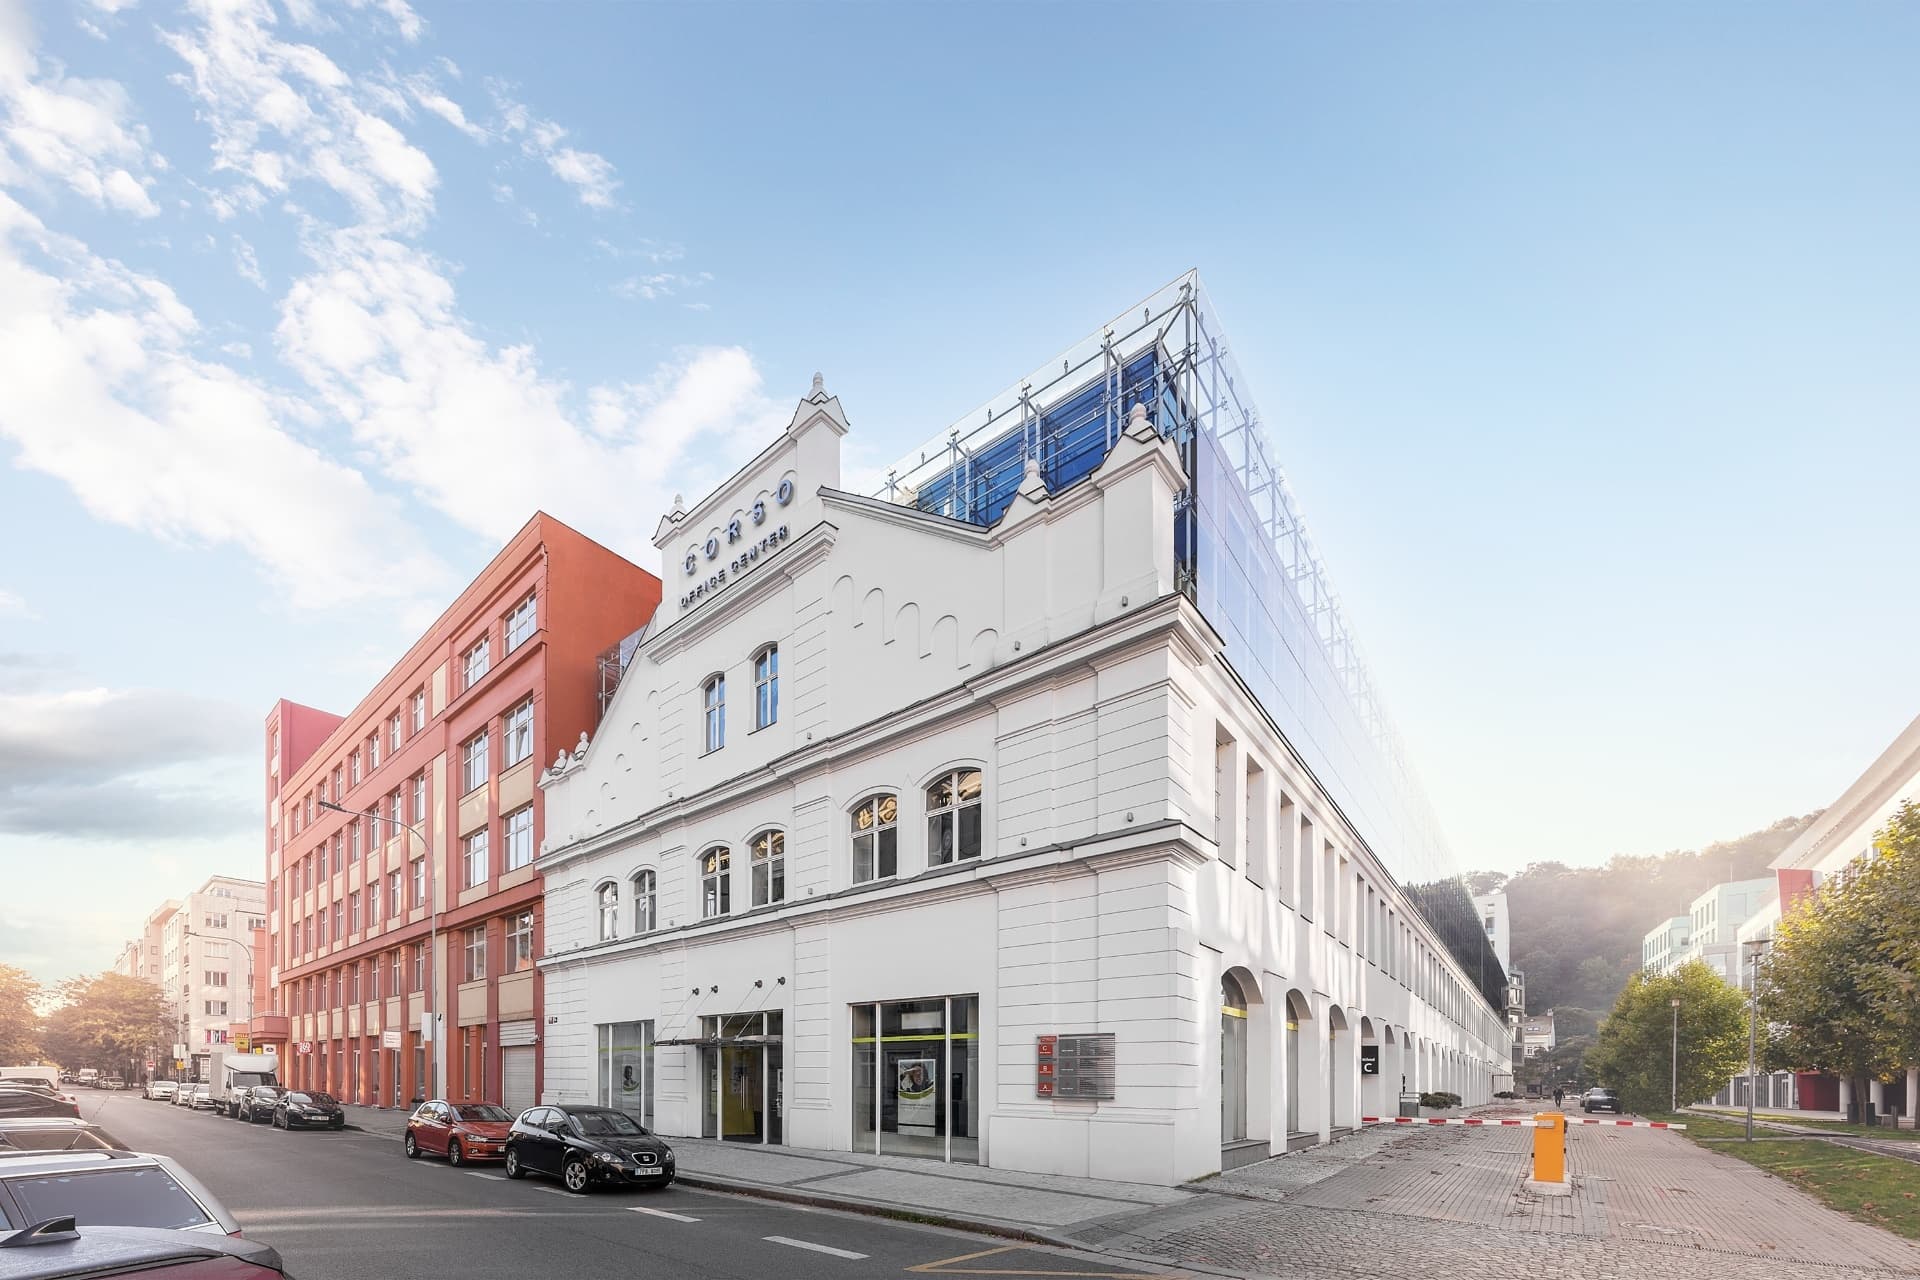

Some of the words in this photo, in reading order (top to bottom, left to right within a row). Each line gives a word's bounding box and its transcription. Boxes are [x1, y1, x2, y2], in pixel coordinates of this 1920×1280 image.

[681, 569, 727, 609] OFFICE
[730, 525, 788, 573] CENTER
[684, 479, 794, 576] CORSO
[1364, 1063, 1372, 1072] C
